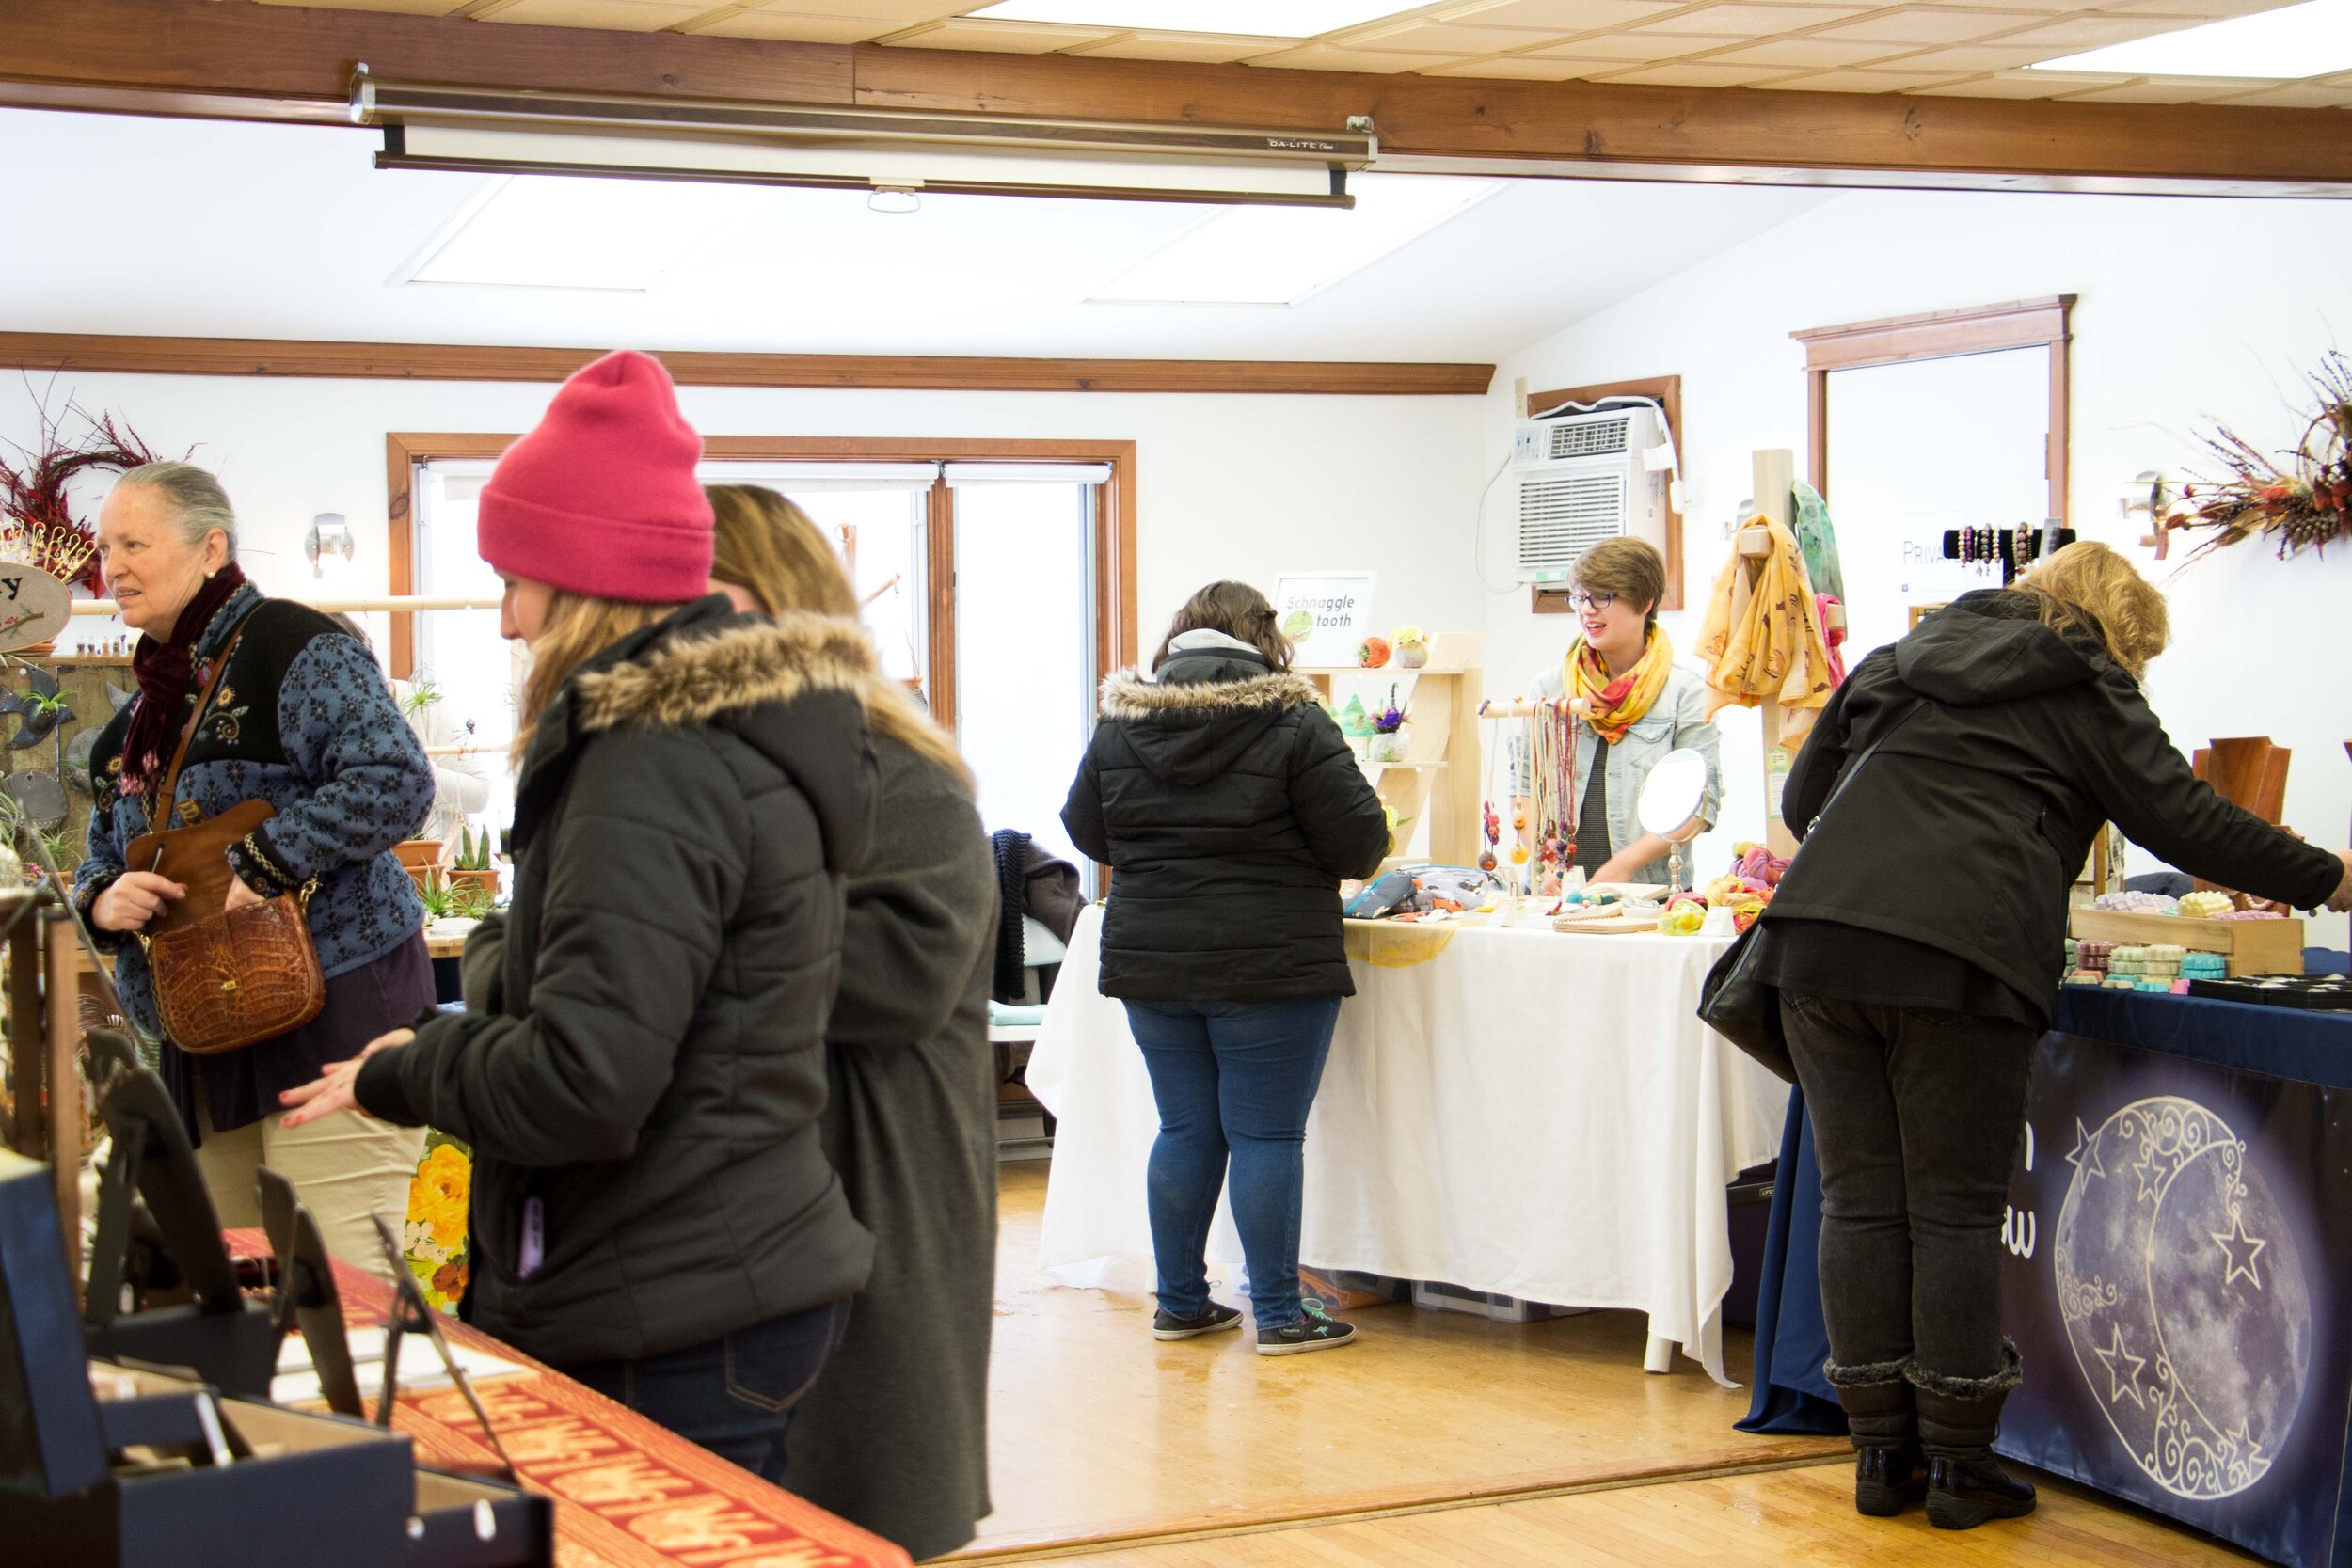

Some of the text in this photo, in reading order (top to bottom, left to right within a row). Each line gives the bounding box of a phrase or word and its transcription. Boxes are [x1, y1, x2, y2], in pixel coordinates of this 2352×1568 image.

[1903, 540, 1963, 565] PRIVA
[1287, 594, 1355, 612] Schnaggle
[1316, 613, 1352, 627] tooth
